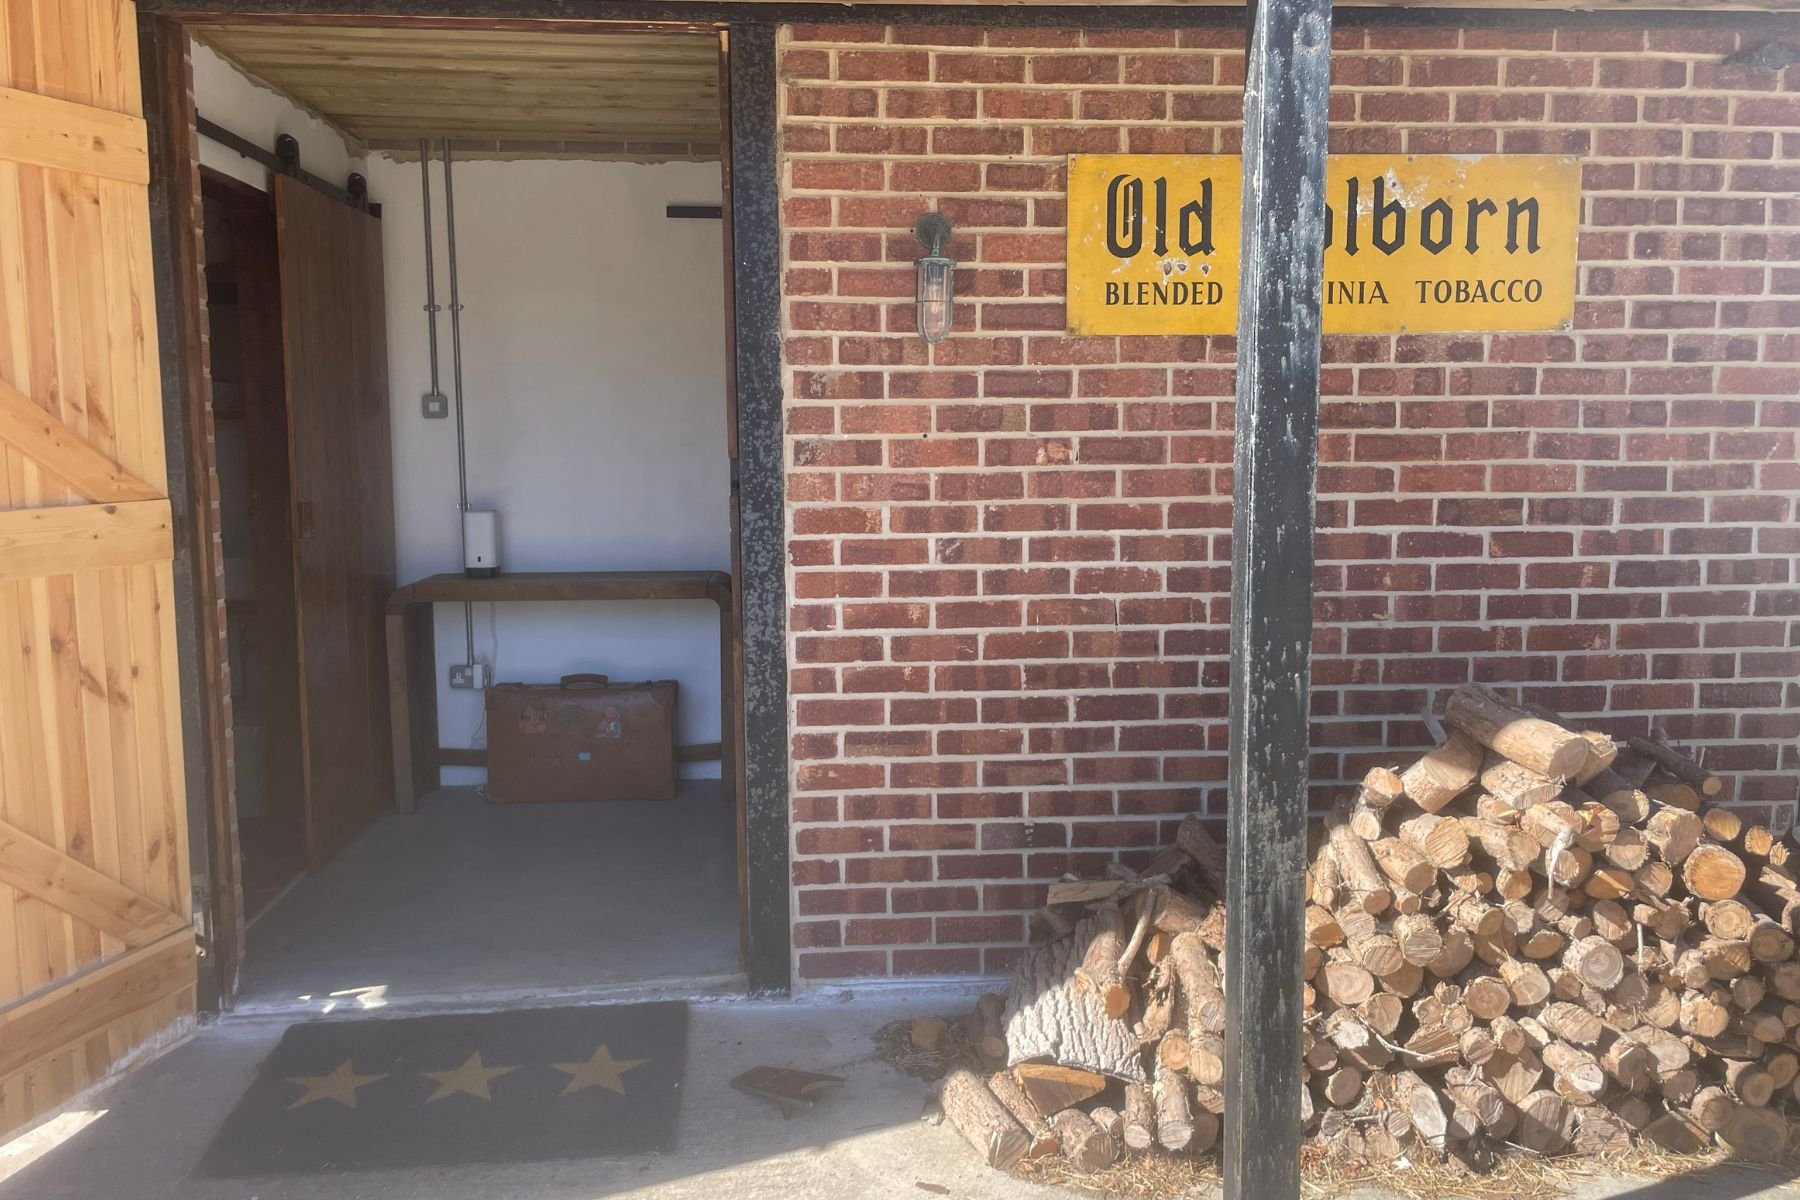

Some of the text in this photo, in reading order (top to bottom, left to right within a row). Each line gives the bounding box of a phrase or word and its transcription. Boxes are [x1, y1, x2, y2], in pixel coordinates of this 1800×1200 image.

[1106, 173, 1541, 259] Old lborn
[1104, 281, 1223, 306] BLENDED
[1415, 279, 1543, 304] TOBACCO
